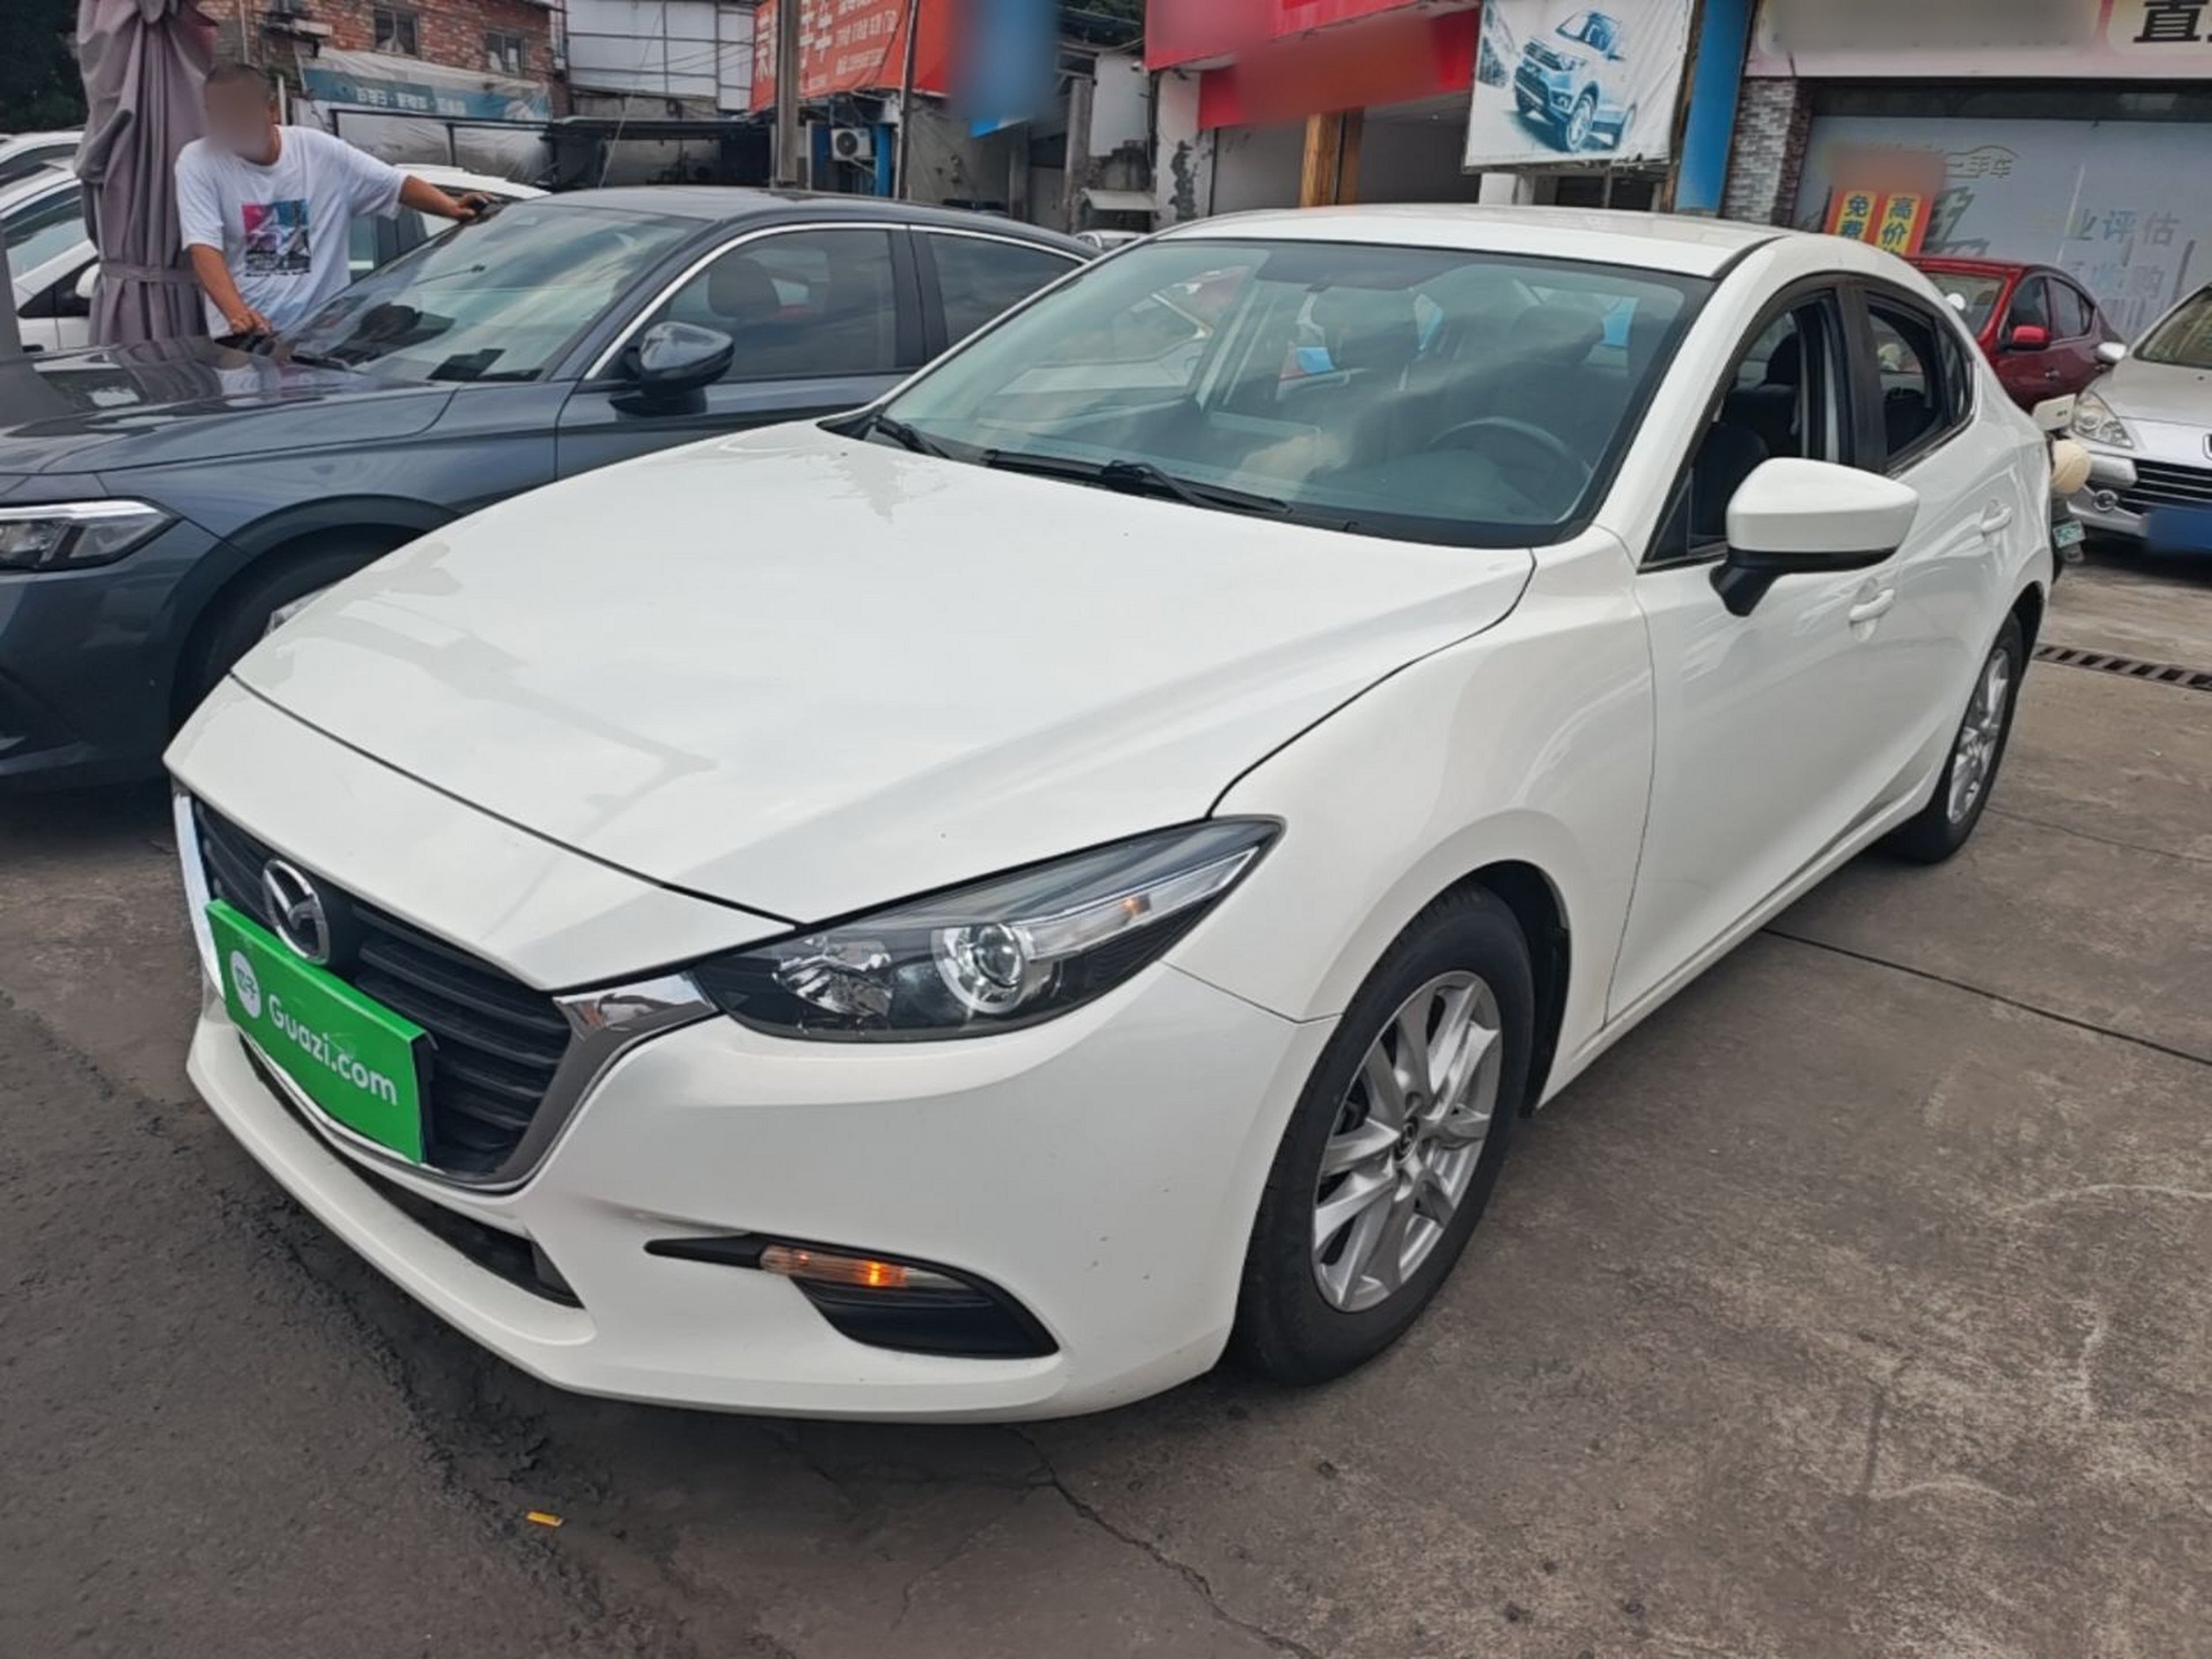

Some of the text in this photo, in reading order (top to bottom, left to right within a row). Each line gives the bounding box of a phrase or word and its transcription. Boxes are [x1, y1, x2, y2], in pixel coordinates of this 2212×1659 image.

[2133, 0, 2212, 43] 直
[1840, 194, 1869, 240] 免费
[1880, 196, 1918, 255] 高价
[269, 994, 397, 1106] Guazi.com
